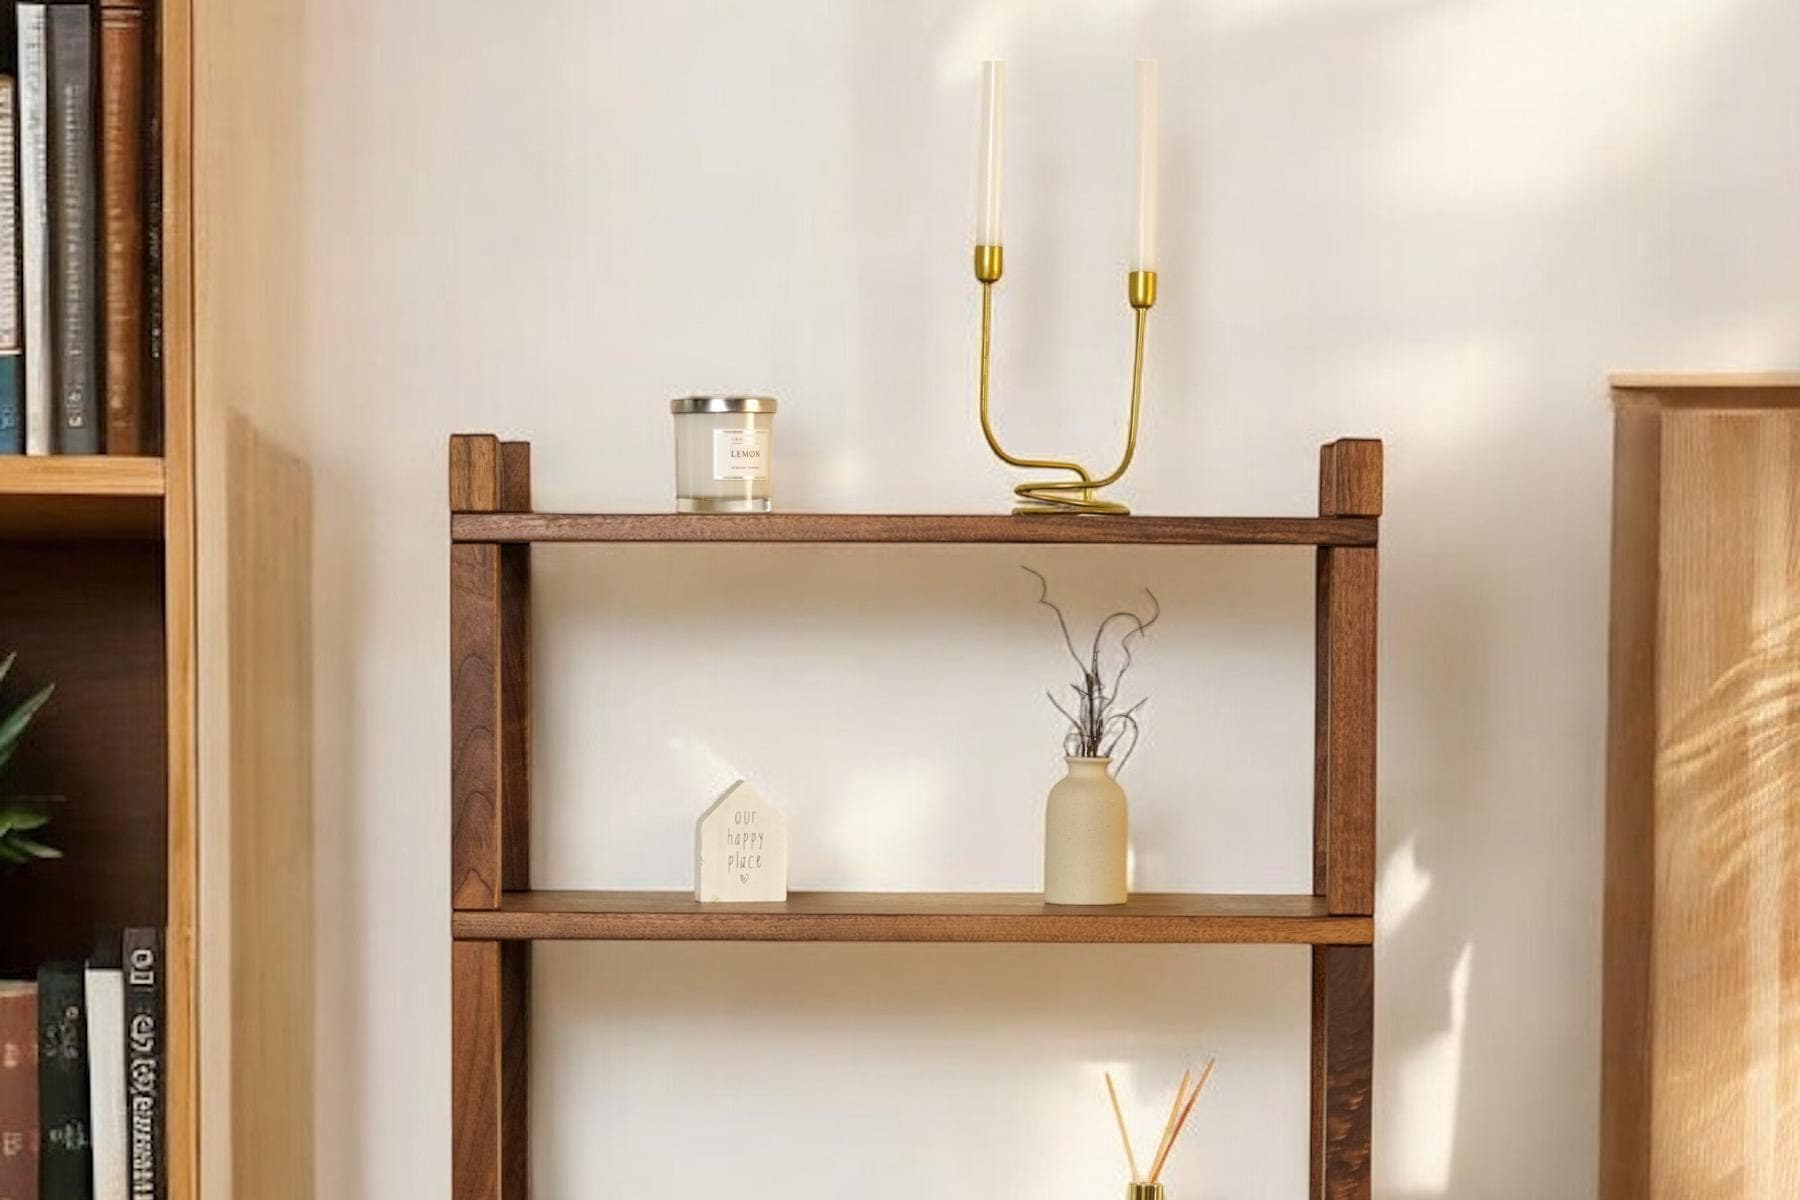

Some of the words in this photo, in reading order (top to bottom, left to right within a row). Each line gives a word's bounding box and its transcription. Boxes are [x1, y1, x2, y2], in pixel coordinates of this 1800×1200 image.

[730, 449, 760, 458] LEMON
[734, 811, 756, 825] our
[727, 828, 764, 850] happy
[727, 851, 762, 873] place
